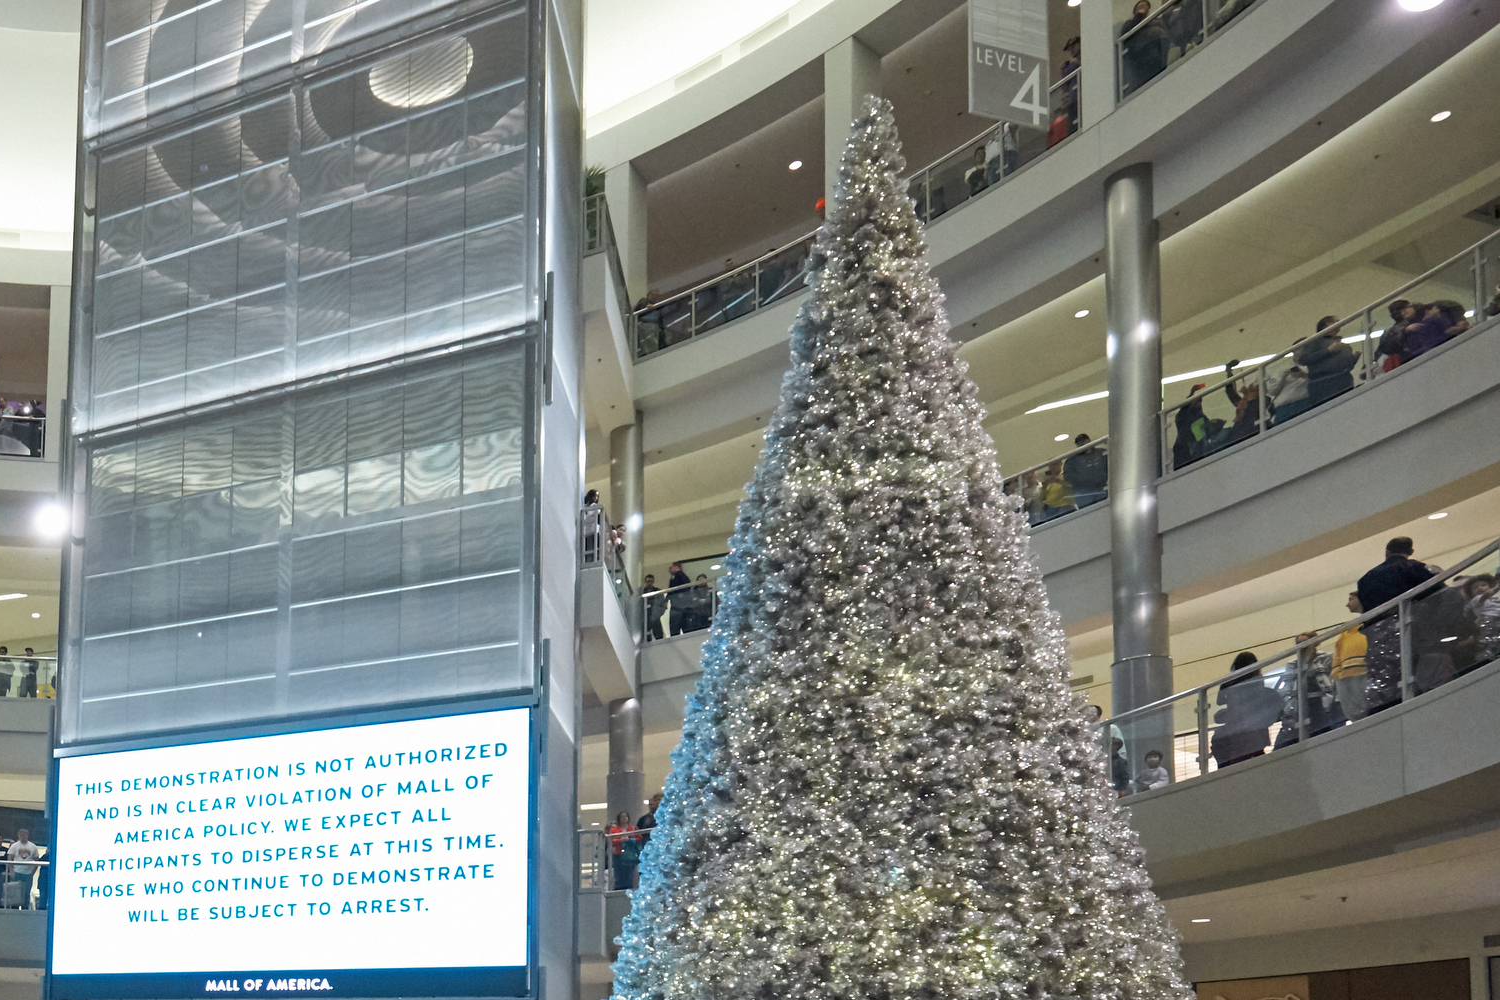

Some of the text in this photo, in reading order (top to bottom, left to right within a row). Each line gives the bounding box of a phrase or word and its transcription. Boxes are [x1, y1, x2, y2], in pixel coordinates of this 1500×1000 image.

[976, 46, 1026, 74] LEVEL
[1009, 62, 1049, 126] 4
[75, 742, 508, 796] THIS DEMONSTRATION IS NOT AUTHORIZED
[83, 773, 494, 821] AND IS IN CLEAR VIOLATION OF MALL OF
[114, 807, 452, 845] AMERICA POLICY. WE EXPECT ALL
[73, 833, 504, 873] PARTICIPANTS TO DISPERSE AT THIS TIME.
[79, 863, 495, 898] THOSE WHO CONTINUE TO DEMONSTRATE
[128, 897, 430, 923] WILL BE SUBJECT TO ARREST.
[205, 979, 241, 992] MALL
[243, 978, 264, 992] OF
